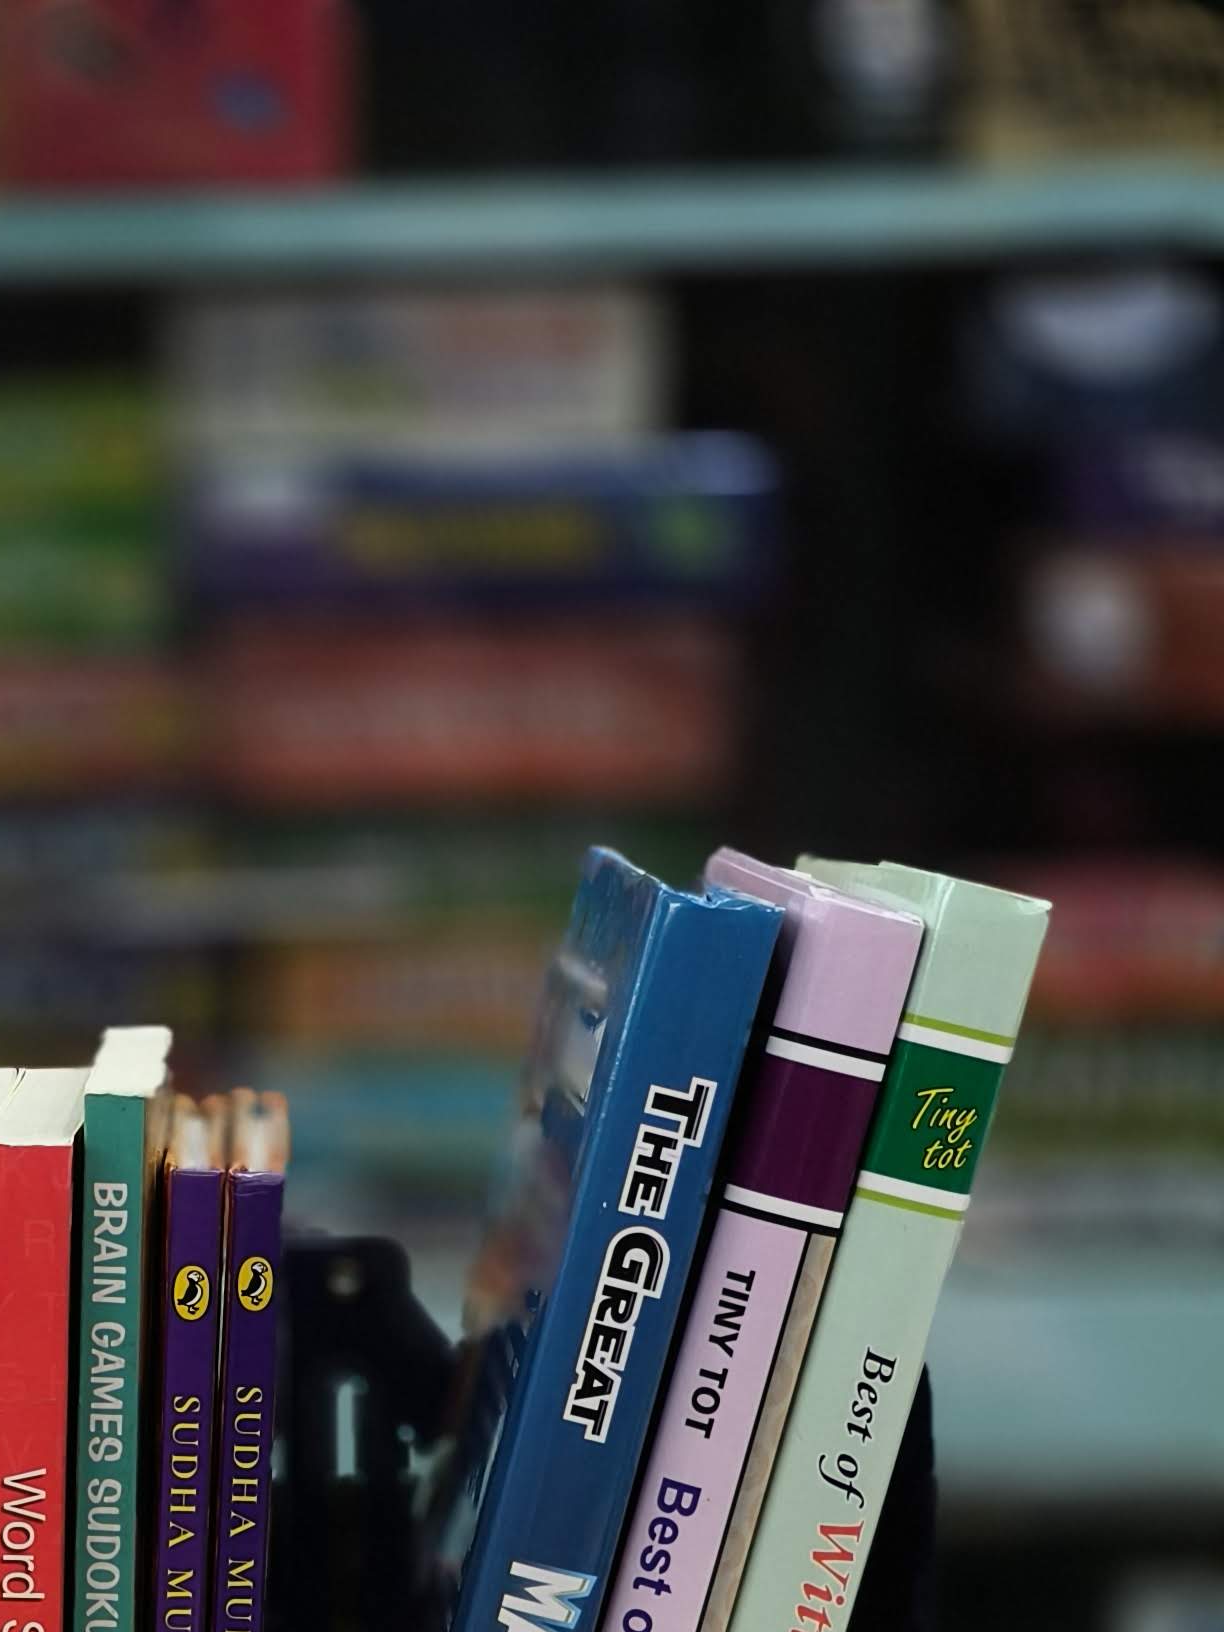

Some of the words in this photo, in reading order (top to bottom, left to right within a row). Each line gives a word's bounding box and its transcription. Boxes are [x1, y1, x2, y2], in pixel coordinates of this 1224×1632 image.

[618, 1076, 718, 1220] THE
[911, 1087, 977, 1141] Tiny
[922, 1140, 974, 1170] tot
[91, 1181, 128, 1305] BRAIN
[563, 1226, 670, 1444] GREAT
[704, 1268, 756, 1356] TINY
[87, 1321, 126, 1463] GAMES
[684, 1365, 736, 1439] TOT
[842, 1345, 898, 1442] Best
[167, 1395, 200, 1549] SUDHA
[229, 1385, 264, 1538] SUDHA
[818, 1454, 866, 1507] of
[0, 1468, 47, 1601] Word
[629, 1477, 702, 1599] Best
